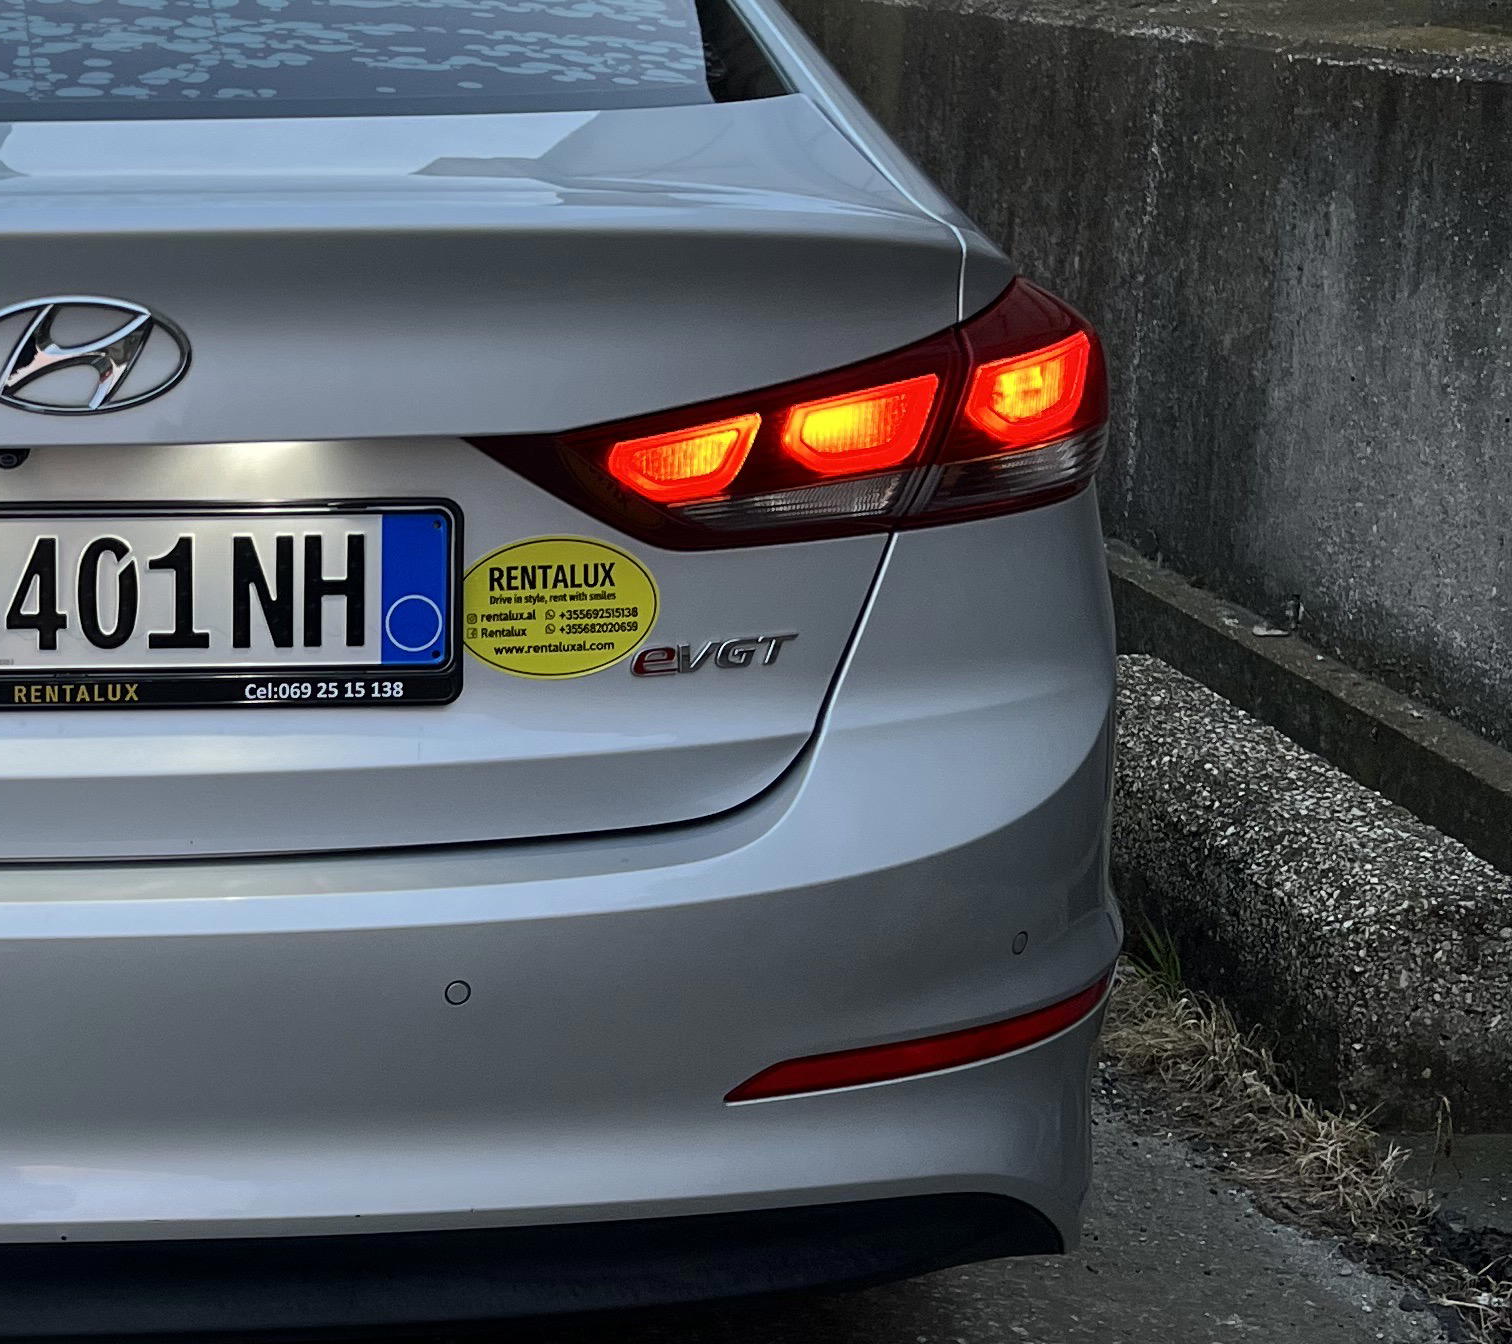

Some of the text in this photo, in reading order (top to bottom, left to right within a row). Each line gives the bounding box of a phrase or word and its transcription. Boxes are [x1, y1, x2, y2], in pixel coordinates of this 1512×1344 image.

[489, 562, 616, 592] RENTALUX
[5, 536, 211, 651] 401
[232, 533, 367, 649] NH
[489, 590, 617, 606] Drive in style, rent with smiles
[480, 609, 537, 623] rentalux.al
[480, 626, 527, 639] Rentalux
[493, 640, 615, 655] www.rentaluxal.com
[13, 683, 140, 703] RENTALUX
[244, 682, 312, 700] Cel:069
[316, 682, 339, 699] 25
[344, 681, 366, 698] 15
[370, 681, 405, 698] 138
